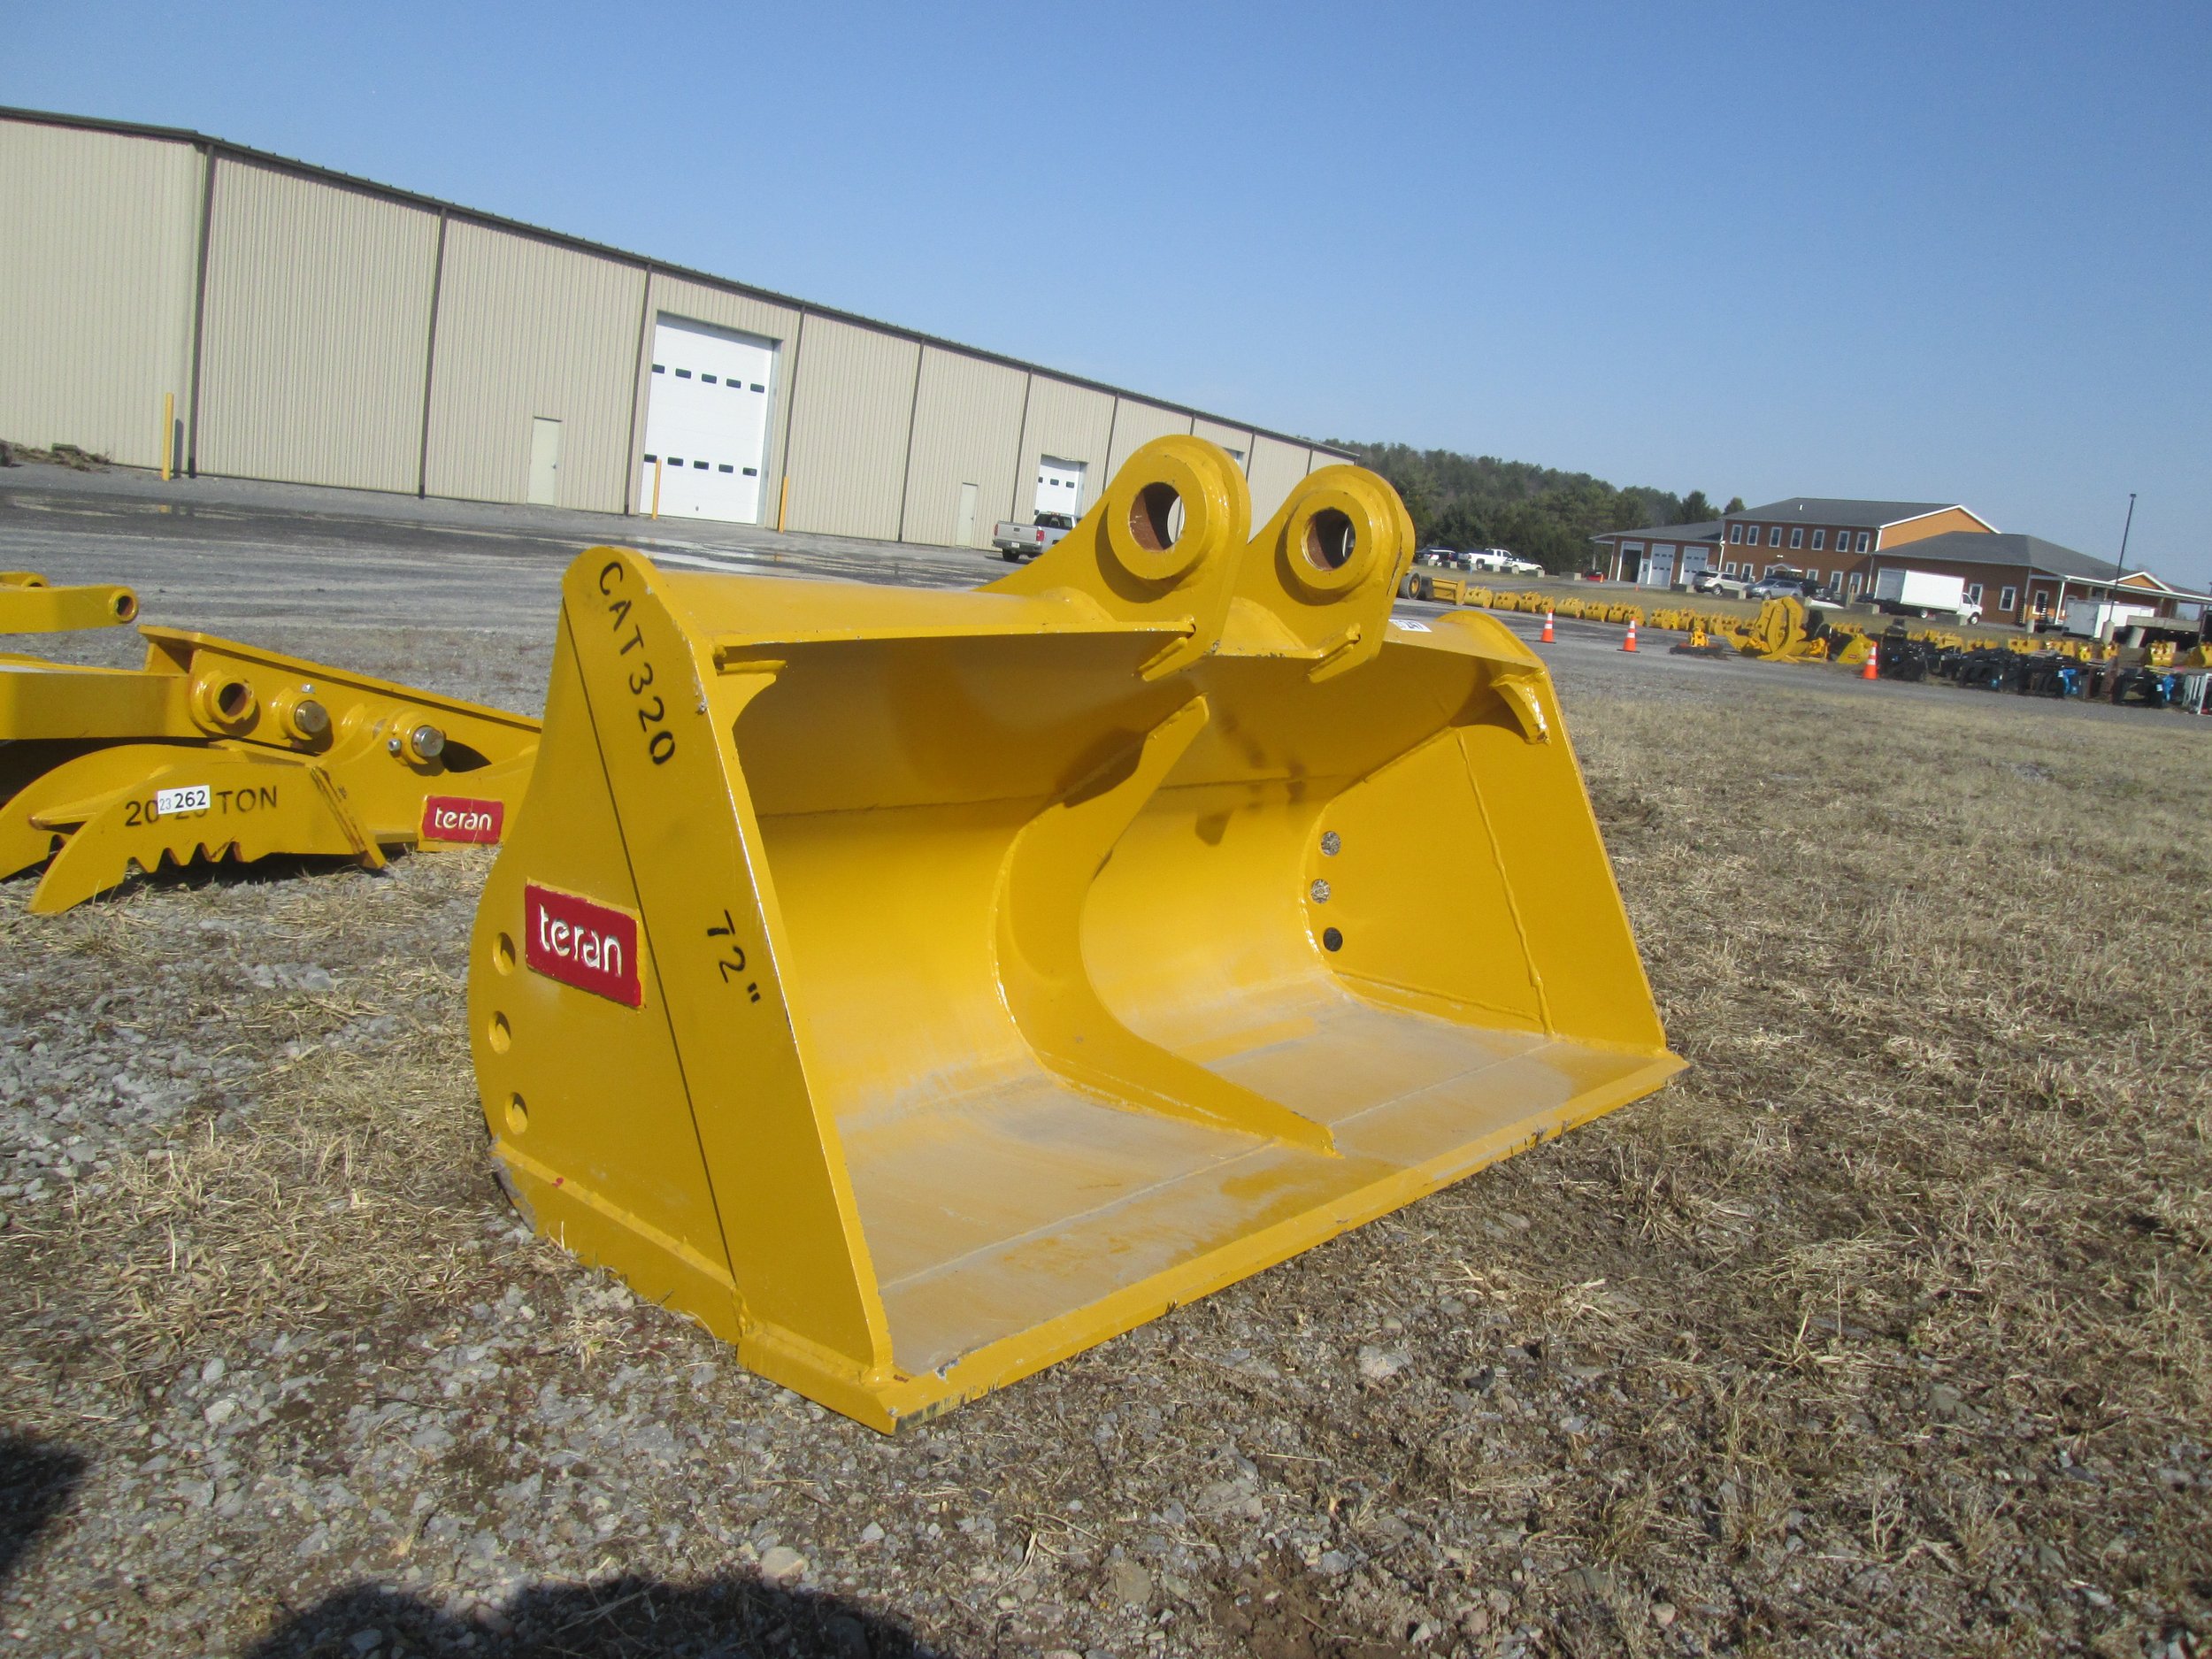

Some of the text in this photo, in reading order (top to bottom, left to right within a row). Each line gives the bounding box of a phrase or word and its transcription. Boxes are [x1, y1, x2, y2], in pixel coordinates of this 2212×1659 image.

[159, 790, 206, 810] 23 262
[216, 785, 277, 814] TON
[434, 807, 492, 832] teran
[538, 902, 622, 978] teran
[707, 909, 760, 1002] 72"
